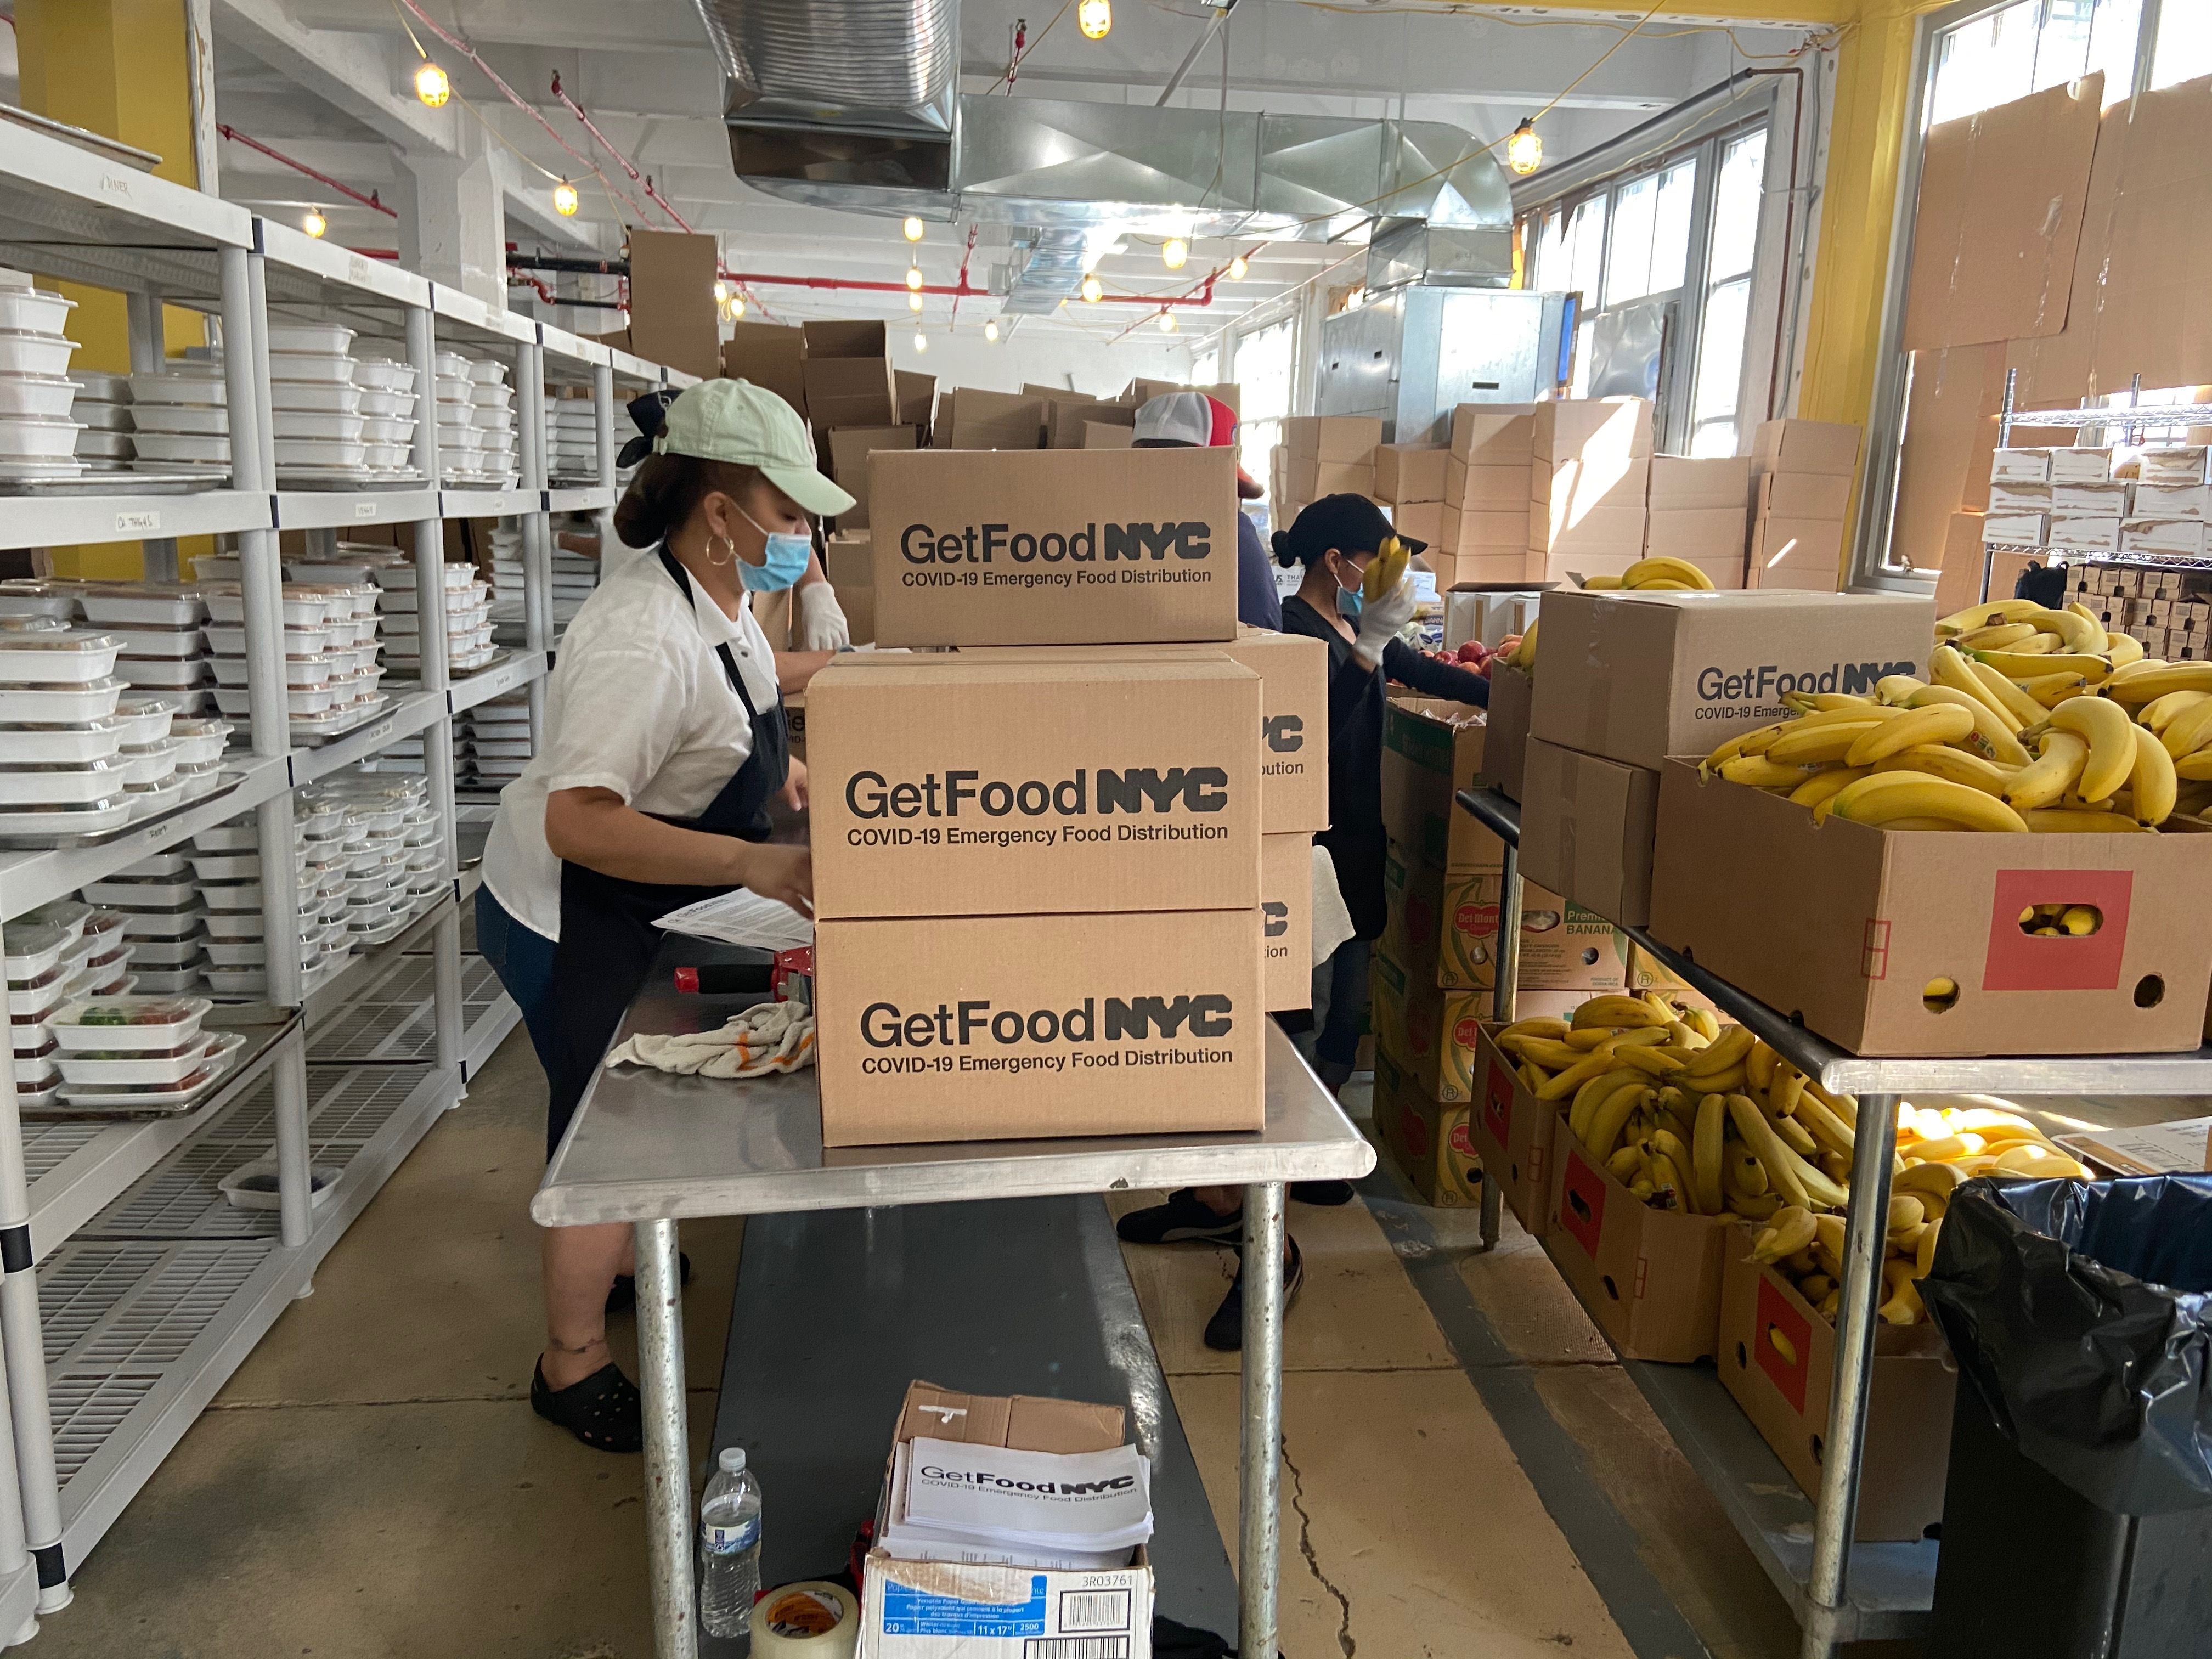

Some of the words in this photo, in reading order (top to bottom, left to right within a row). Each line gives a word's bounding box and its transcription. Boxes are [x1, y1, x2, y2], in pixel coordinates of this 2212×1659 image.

[902, 571, 978, 587] COVID-19
[983, 571, 1073, 589] Emergency
[1077, 569, 1116, 584] Food
[1122, 568, 1211, 584] Distribution
[1695, 706, 1750, 720] COVID-19
[1754, 706, 1800, 718] Emerge
[847, 828, 940, 845] COVID-19
[947, 827, 1057, 847] Emergency
[1063, 826, 1111, 842] Food
[1118, 823, 1228, 841] Distribution
[1458, 913, 1472, 923] Del
[1475, 913, 1499, 923] Mont
[1458, 1028, 1472, 1036] Del
[862, 1057, 953, 1074] COVID-19
[960, 1053, 1066, 1074] Emergency
[1071, 1051, 1119, 1067] Food
[1125, 1048, 1232, 1065] Distribution
[921, 1479, 975, 1490] COVID-19
[978, 1486, 1040, 1500] Emergency
[1043, 1494, 1071, 1502] Food
[1075, 1488, 1137, 1502] Distribution
[885, 1622, 900, 1633] 20
[978, 1624, 988, 1635] 11
